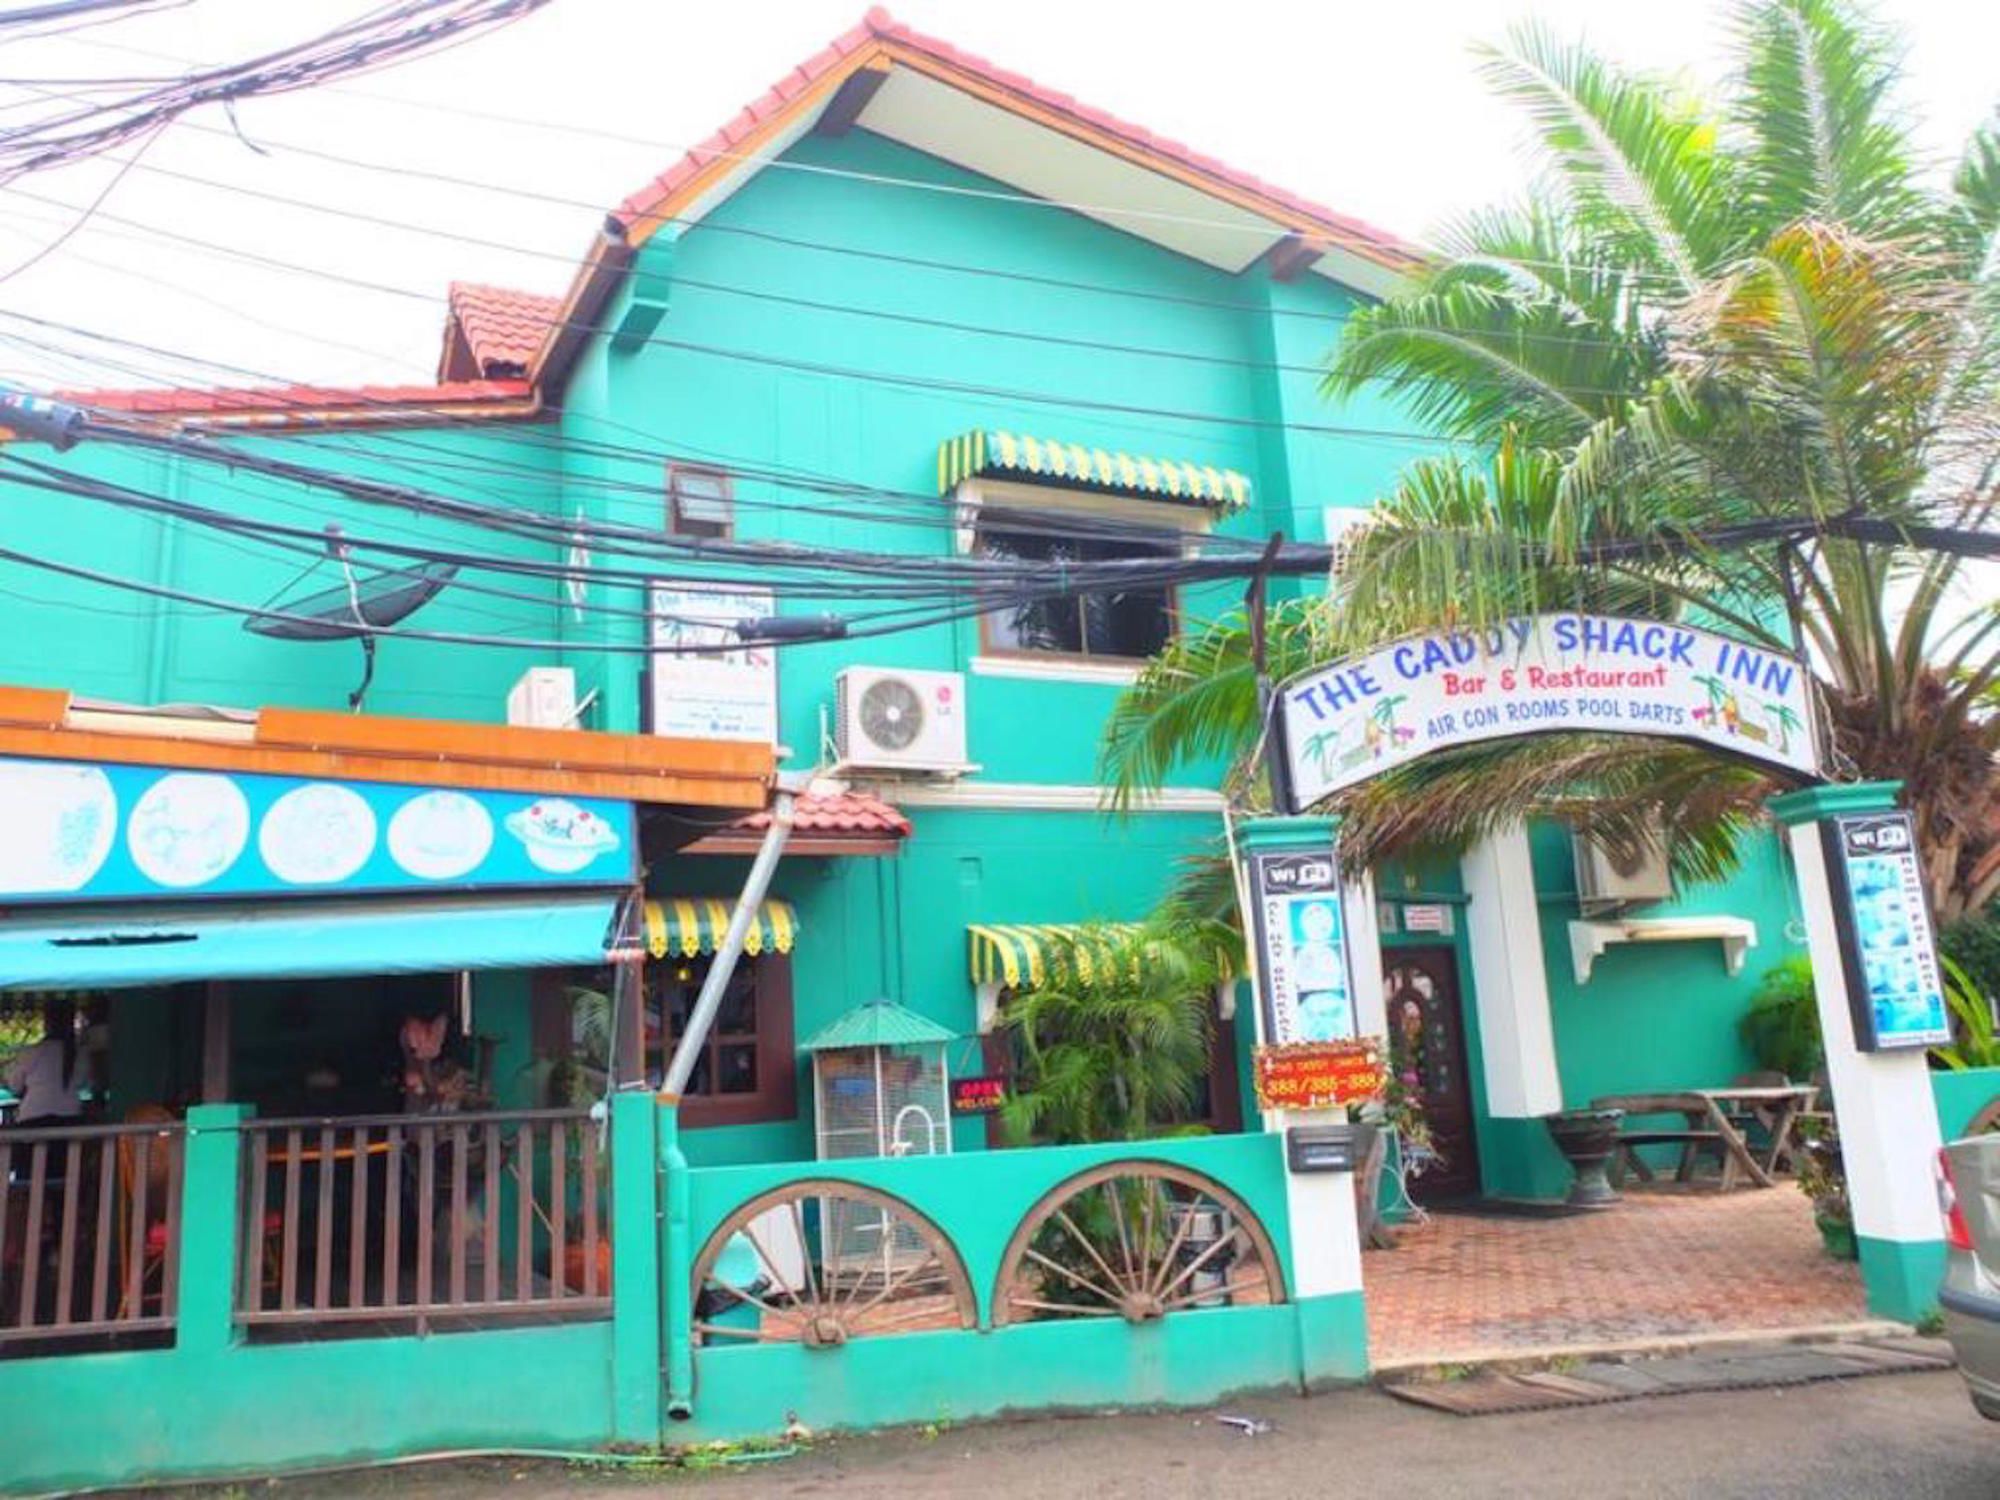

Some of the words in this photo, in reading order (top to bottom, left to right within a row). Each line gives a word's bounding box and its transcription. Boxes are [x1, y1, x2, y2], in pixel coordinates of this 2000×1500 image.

[1294, 664, 1382, 720] THE
[1394, 618, 1531, 680] CADDY
[1553, 617, 1696, 668] SHACK
[1716, 643, 1794, 697] INN
[1442, 672, 1486, 696] Bar
[1500, 669, 1517, 691] &
[1528, 661, 1668, 689] Restaurant
[1427, 716, 1457, 740] AIR
[1464, 704, 1499, 729] CON
[1507, 699, 1569, 721] ROOMS
[1577, 698, 1622, 718] POOL
[1629, 702, 1685, 725] DARTS
[960, 1081, 1003, 1098] OPEN
